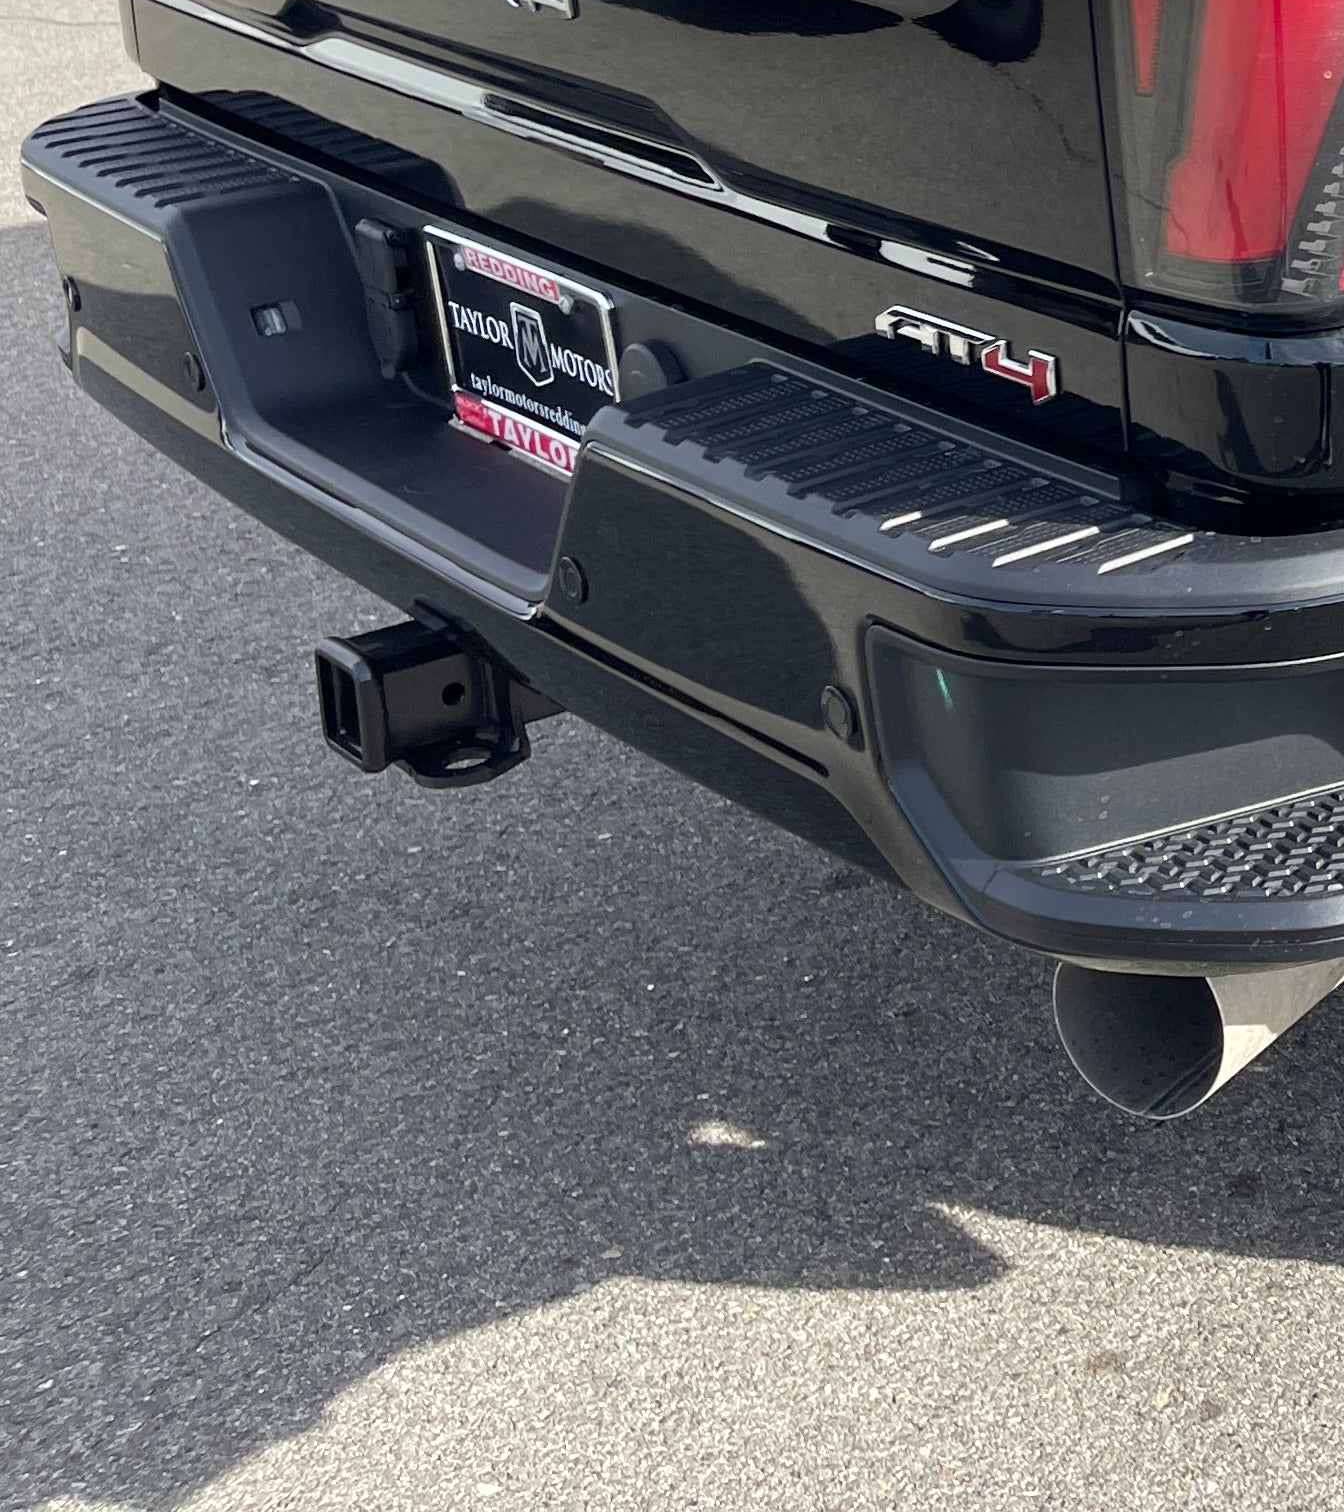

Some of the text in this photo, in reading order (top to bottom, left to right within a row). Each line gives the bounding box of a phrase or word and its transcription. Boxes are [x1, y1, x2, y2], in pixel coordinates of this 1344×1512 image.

[464, 248, 559, 300] REDDING
[447, 300, 515, 350] TAYLOR
[550, 342, 614, 397] MOTORS
[875, 305, 1060, 406] AT4
